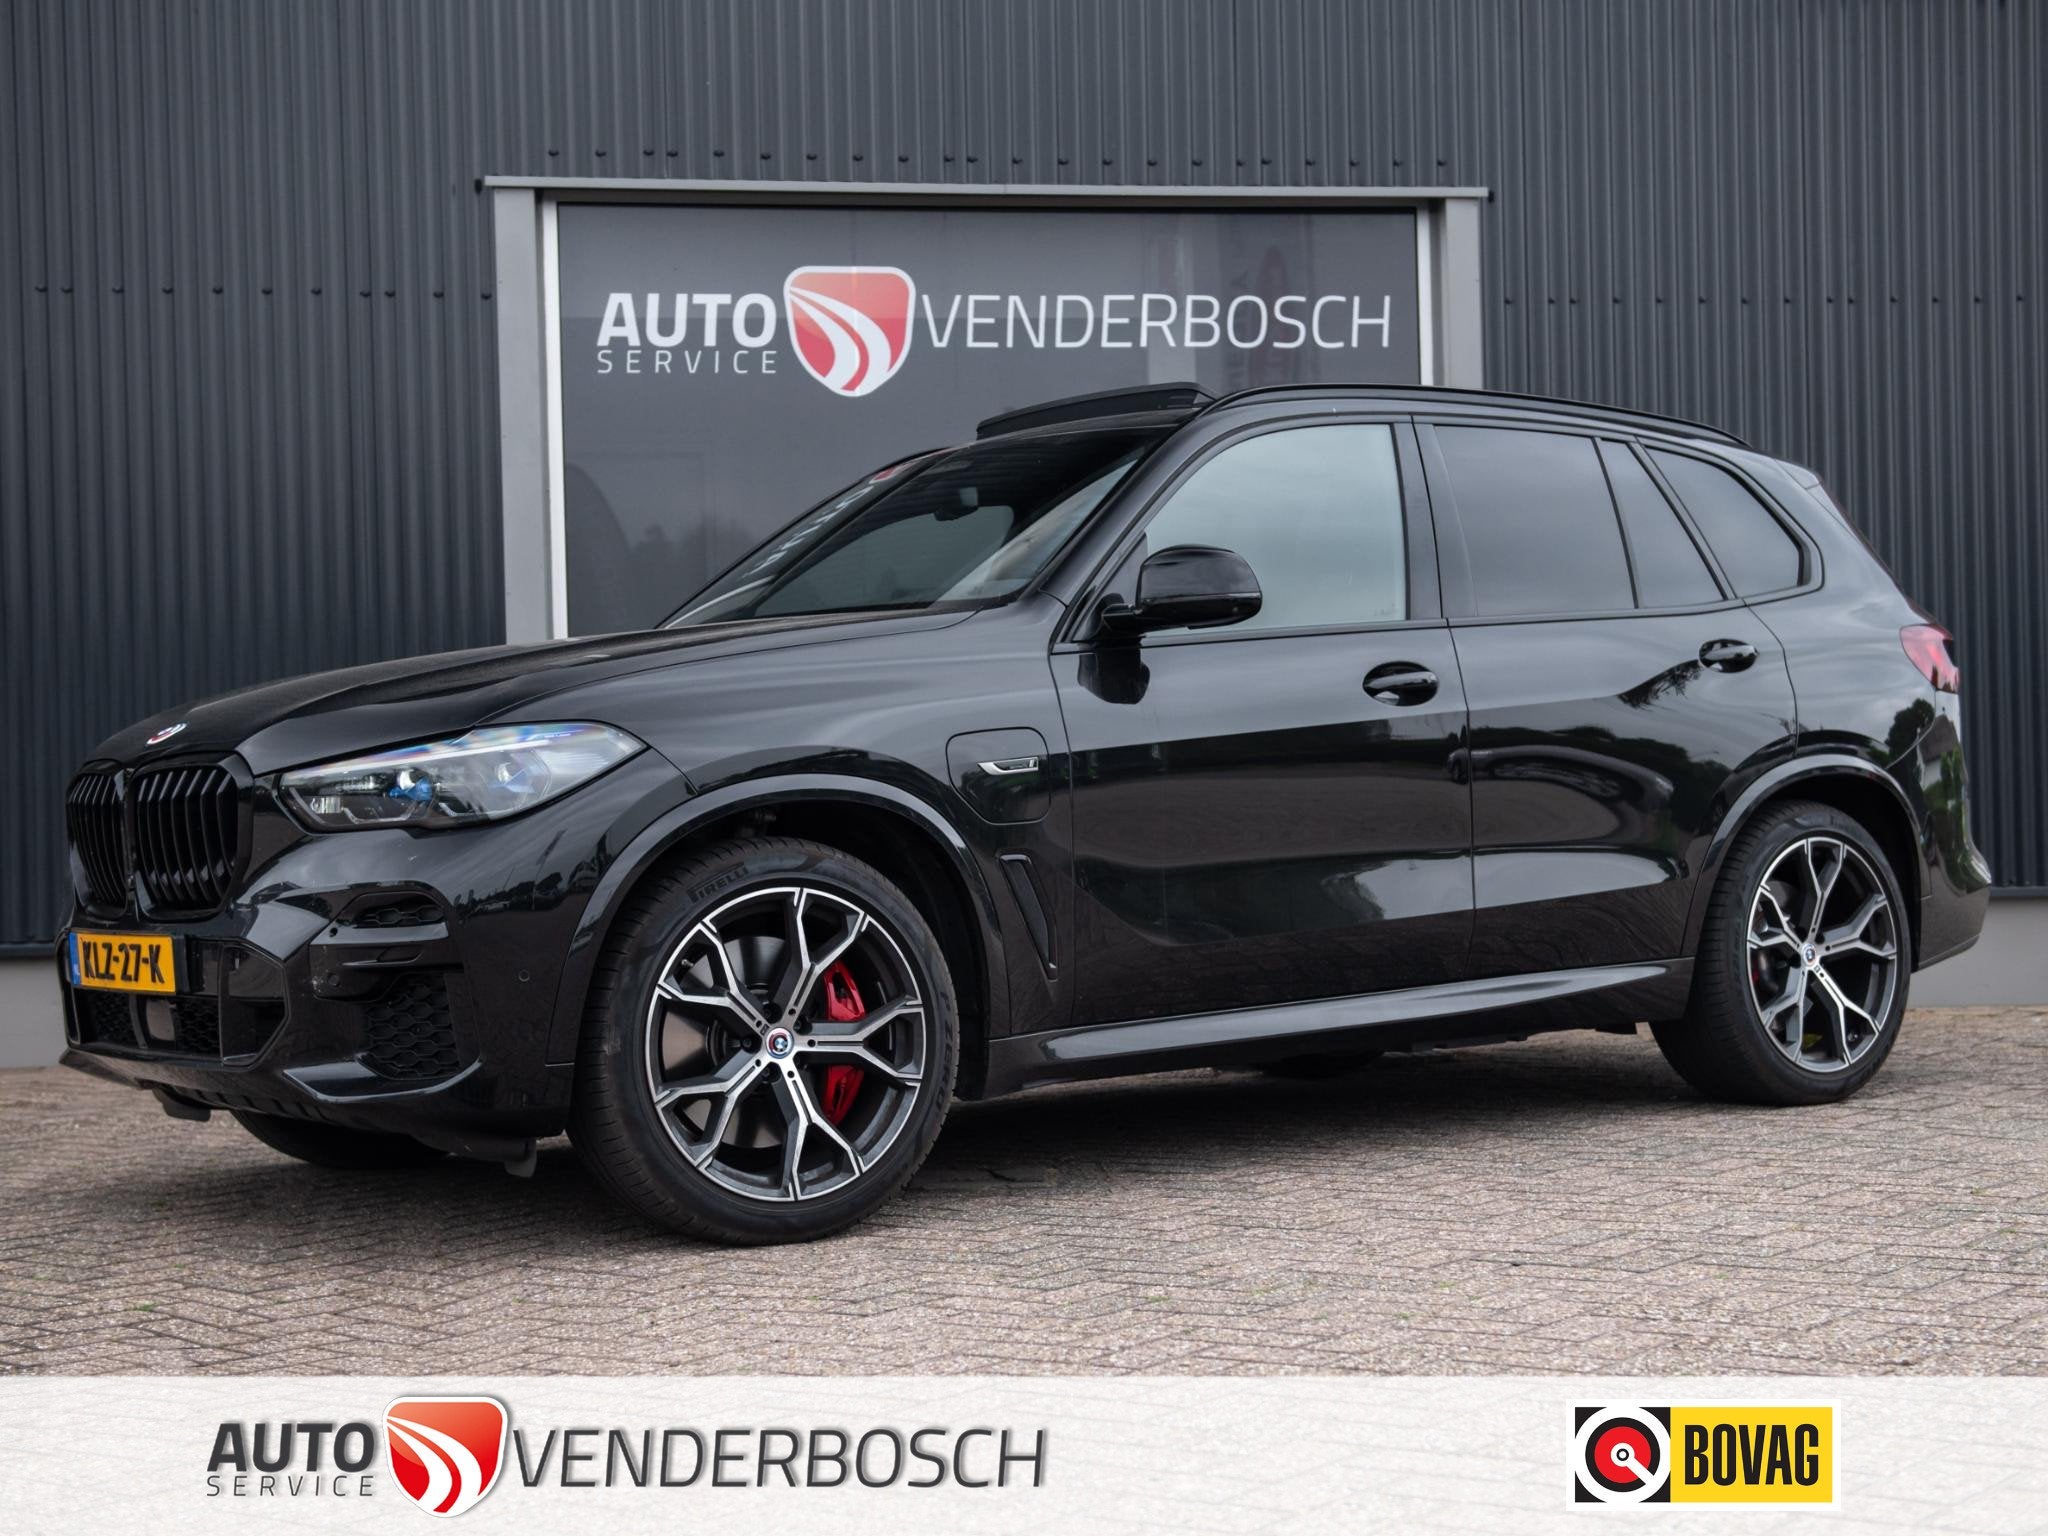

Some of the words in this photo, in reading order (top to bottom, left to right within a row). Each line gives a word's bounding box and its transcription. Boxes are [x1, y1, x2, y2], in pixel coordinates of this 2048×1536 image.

[597, 293, 777, 347] AUTO
[922, 293, 1391, 348] VENDERBOSCH
[597, 350, 777, 374] SERVICE
[82, 941, 165, 983] KLZ-27-K
